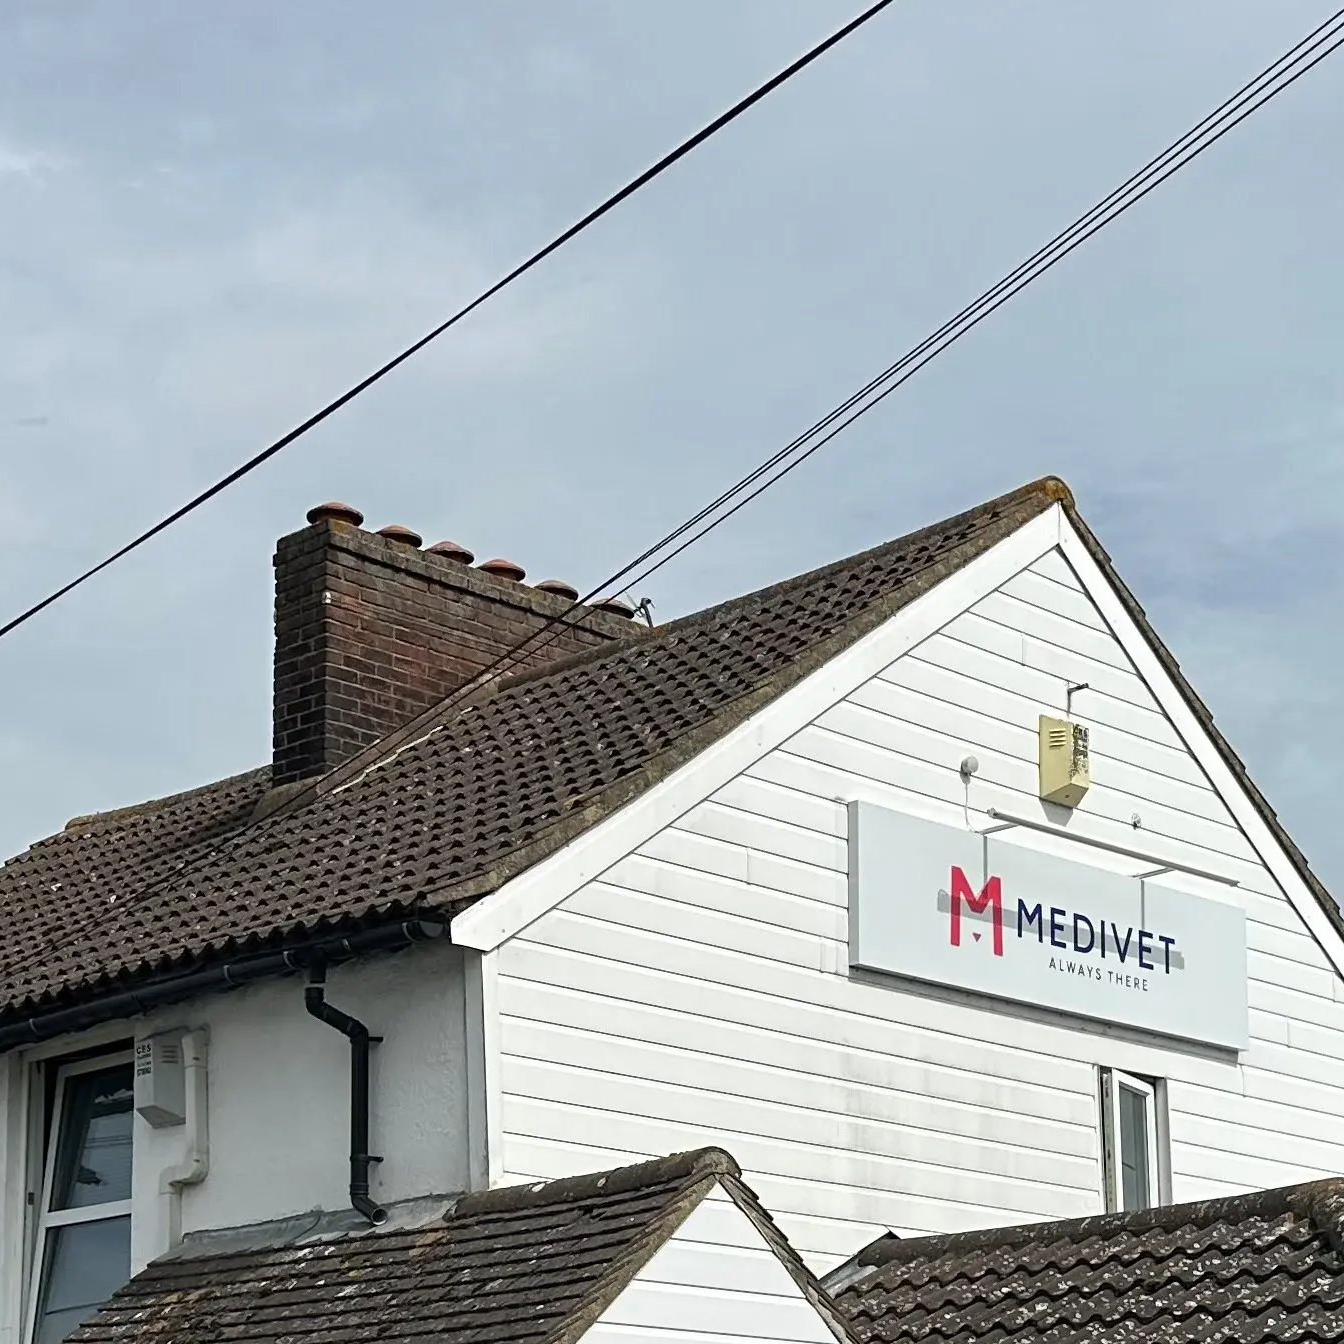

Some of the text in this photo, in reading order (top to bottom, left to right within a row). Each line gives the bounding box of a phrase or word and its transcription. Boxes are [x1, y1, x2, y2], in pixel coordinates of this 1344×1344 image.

[950, 865, 1176, 975] M MEDIVET
[1048, 956, 1148, 992] ALWAYS THERE
